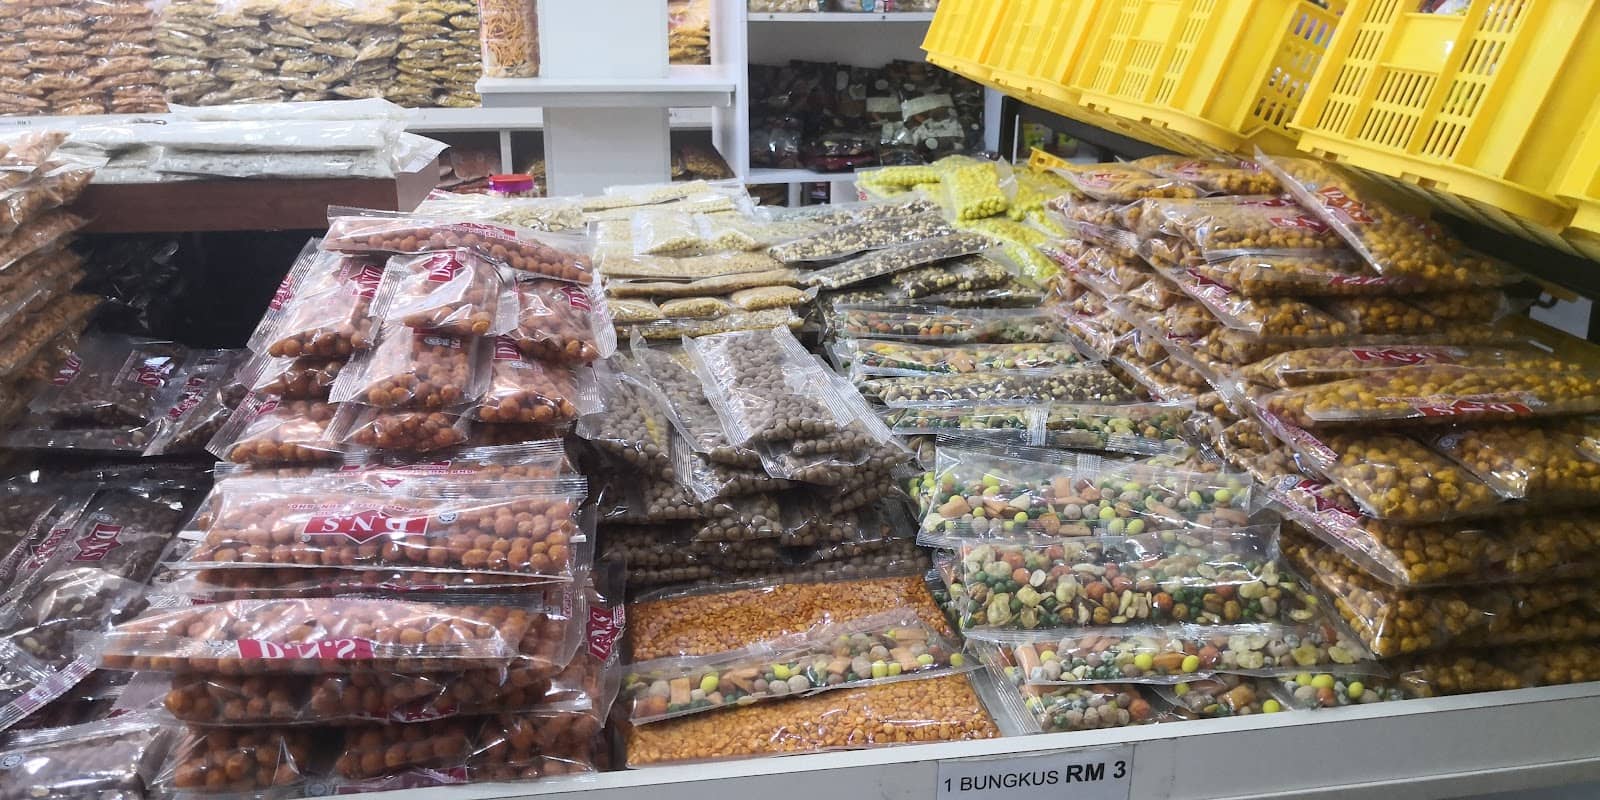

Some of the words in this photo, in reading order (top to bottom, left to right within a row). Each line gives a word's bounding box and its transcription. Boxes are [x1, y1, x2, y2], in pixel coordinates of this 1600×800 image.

[944, 777, 952, 792] 1
[960, 770, 1059, 791] BUNGKUS
[1065, 762, 1105, 783] RM
[1113, 760, 1127, 779] 3
